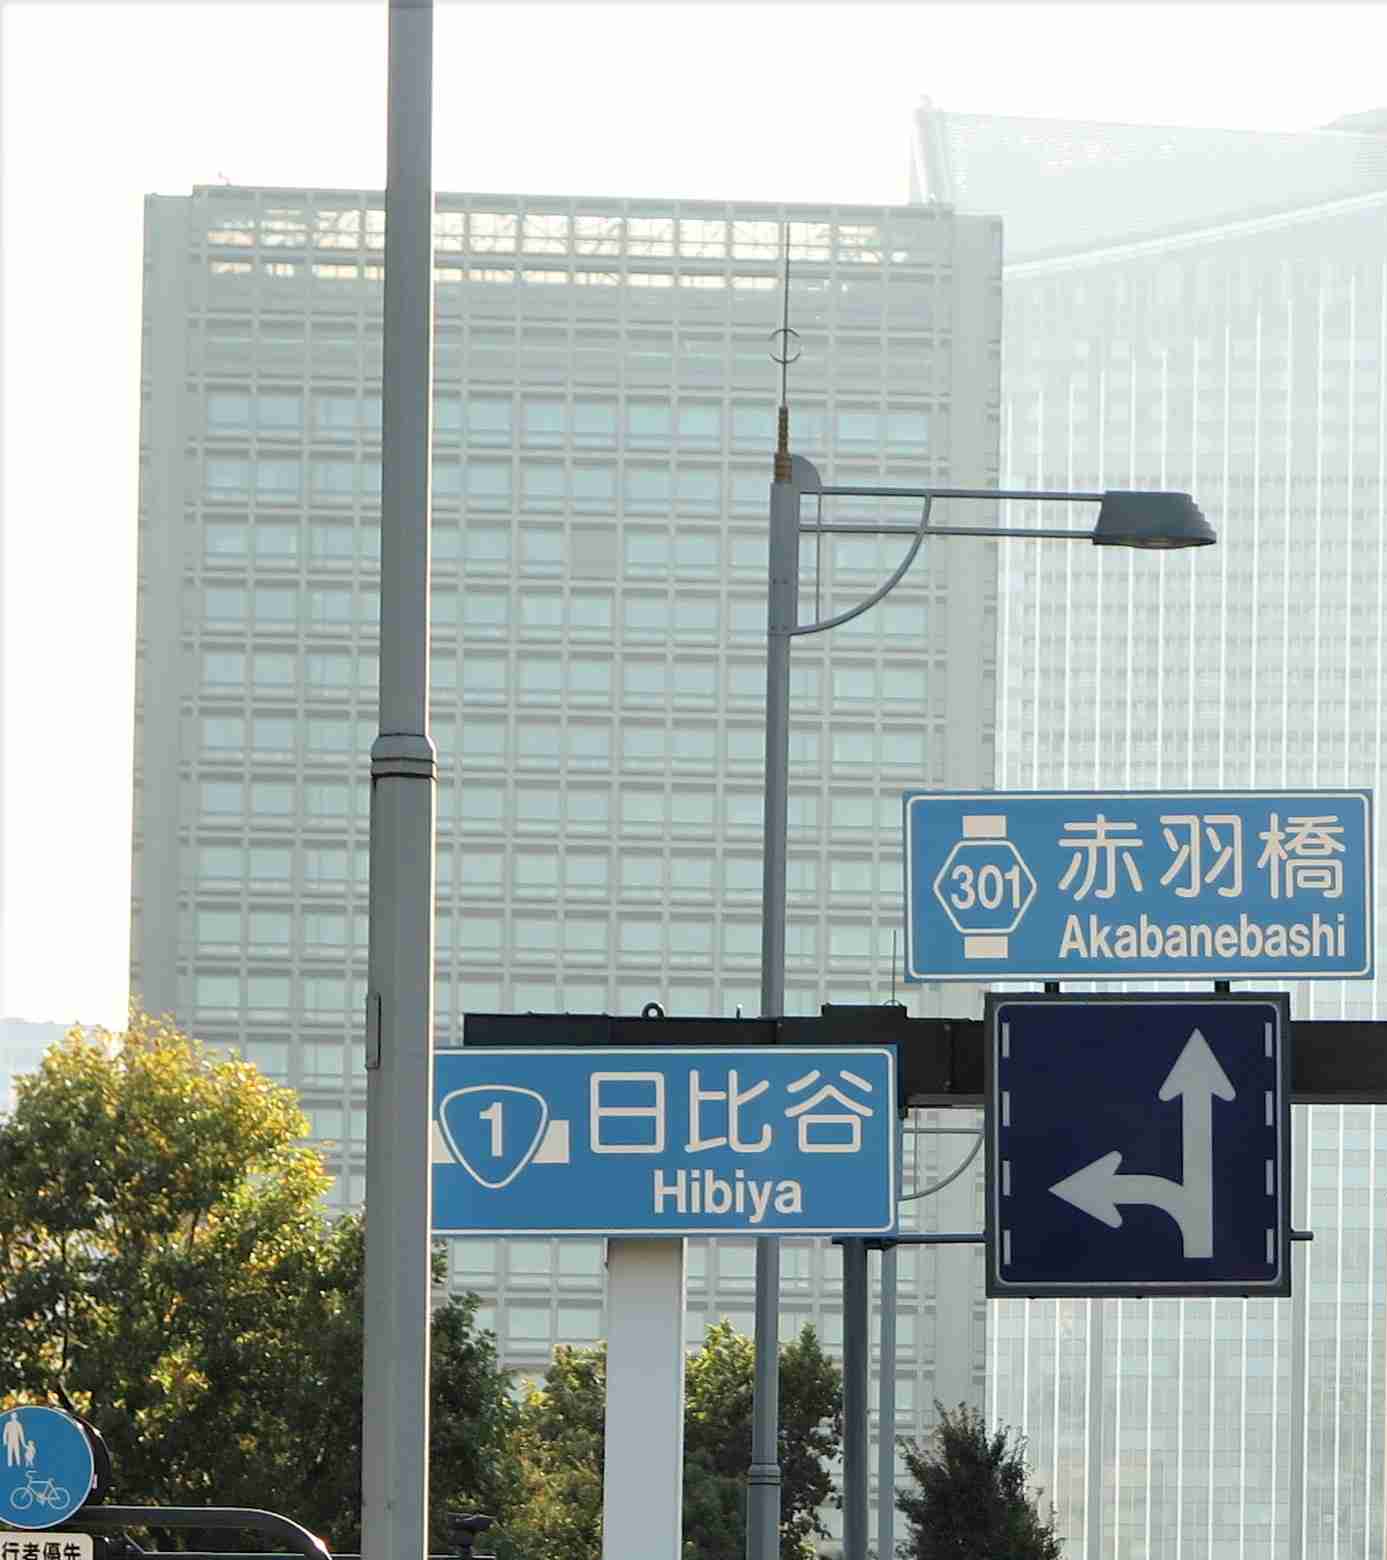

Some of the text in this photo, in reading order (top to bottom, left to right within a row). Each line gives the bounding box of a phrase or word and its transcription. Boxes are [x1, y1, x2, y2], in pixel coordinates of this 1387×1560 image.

[1057, 812, 1347, 901] 赤羽橋
[950, 863, 1024, 911] 301
[1057, 912, 1346, 959] Akabanebashi
[478, 1101, 504, 1158] 1
[589, 1069, 874, 1155] 日比谷
[653, 1168, 803, 1223] Hibiya
